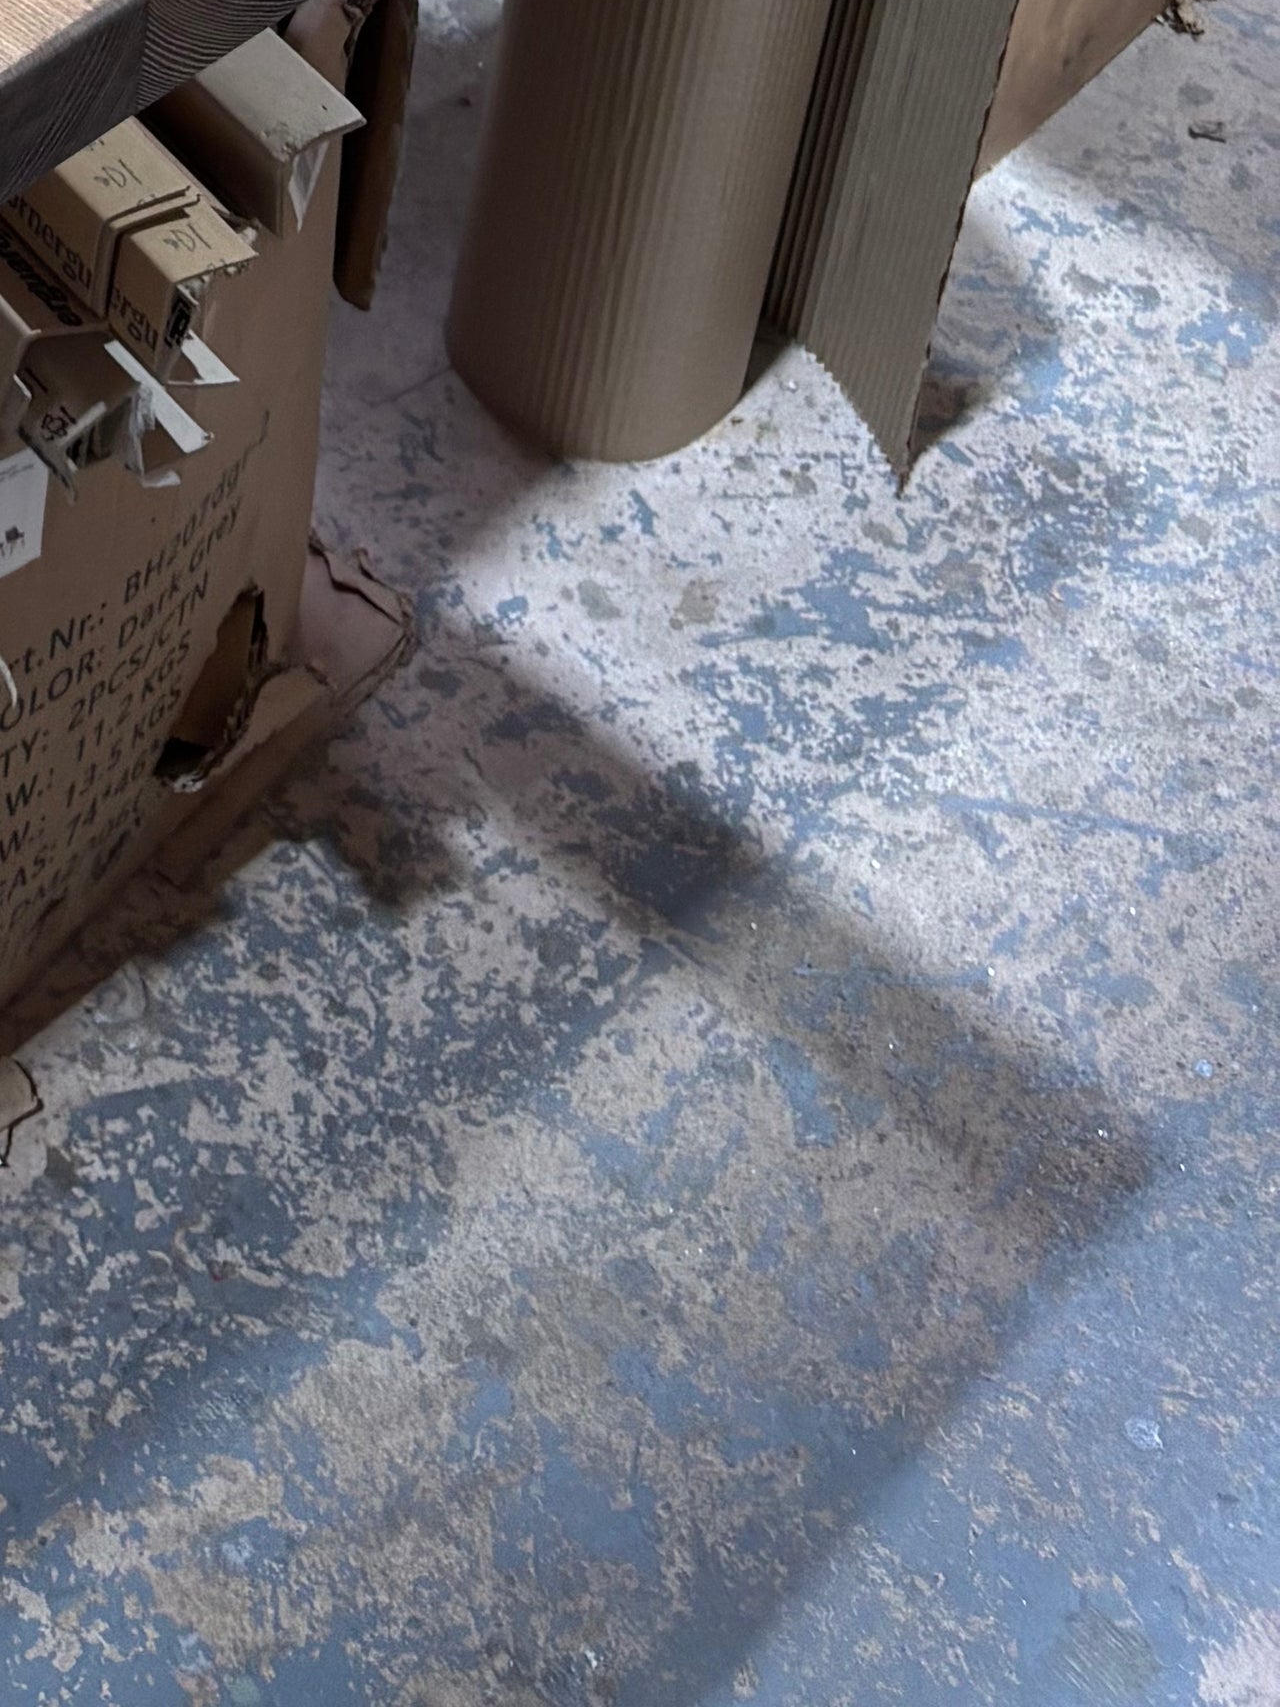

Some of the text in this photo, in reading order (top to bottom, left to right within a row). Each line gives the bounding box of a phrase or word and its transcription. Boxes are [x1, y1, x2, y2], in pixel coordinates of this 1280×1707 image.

[118, 571, 182, 650] Dark
[189, 495, 242, 574] Grey
[68, 570, 209, 733] 2PCS/CTN
[142, 628, 192, 703] KGS
